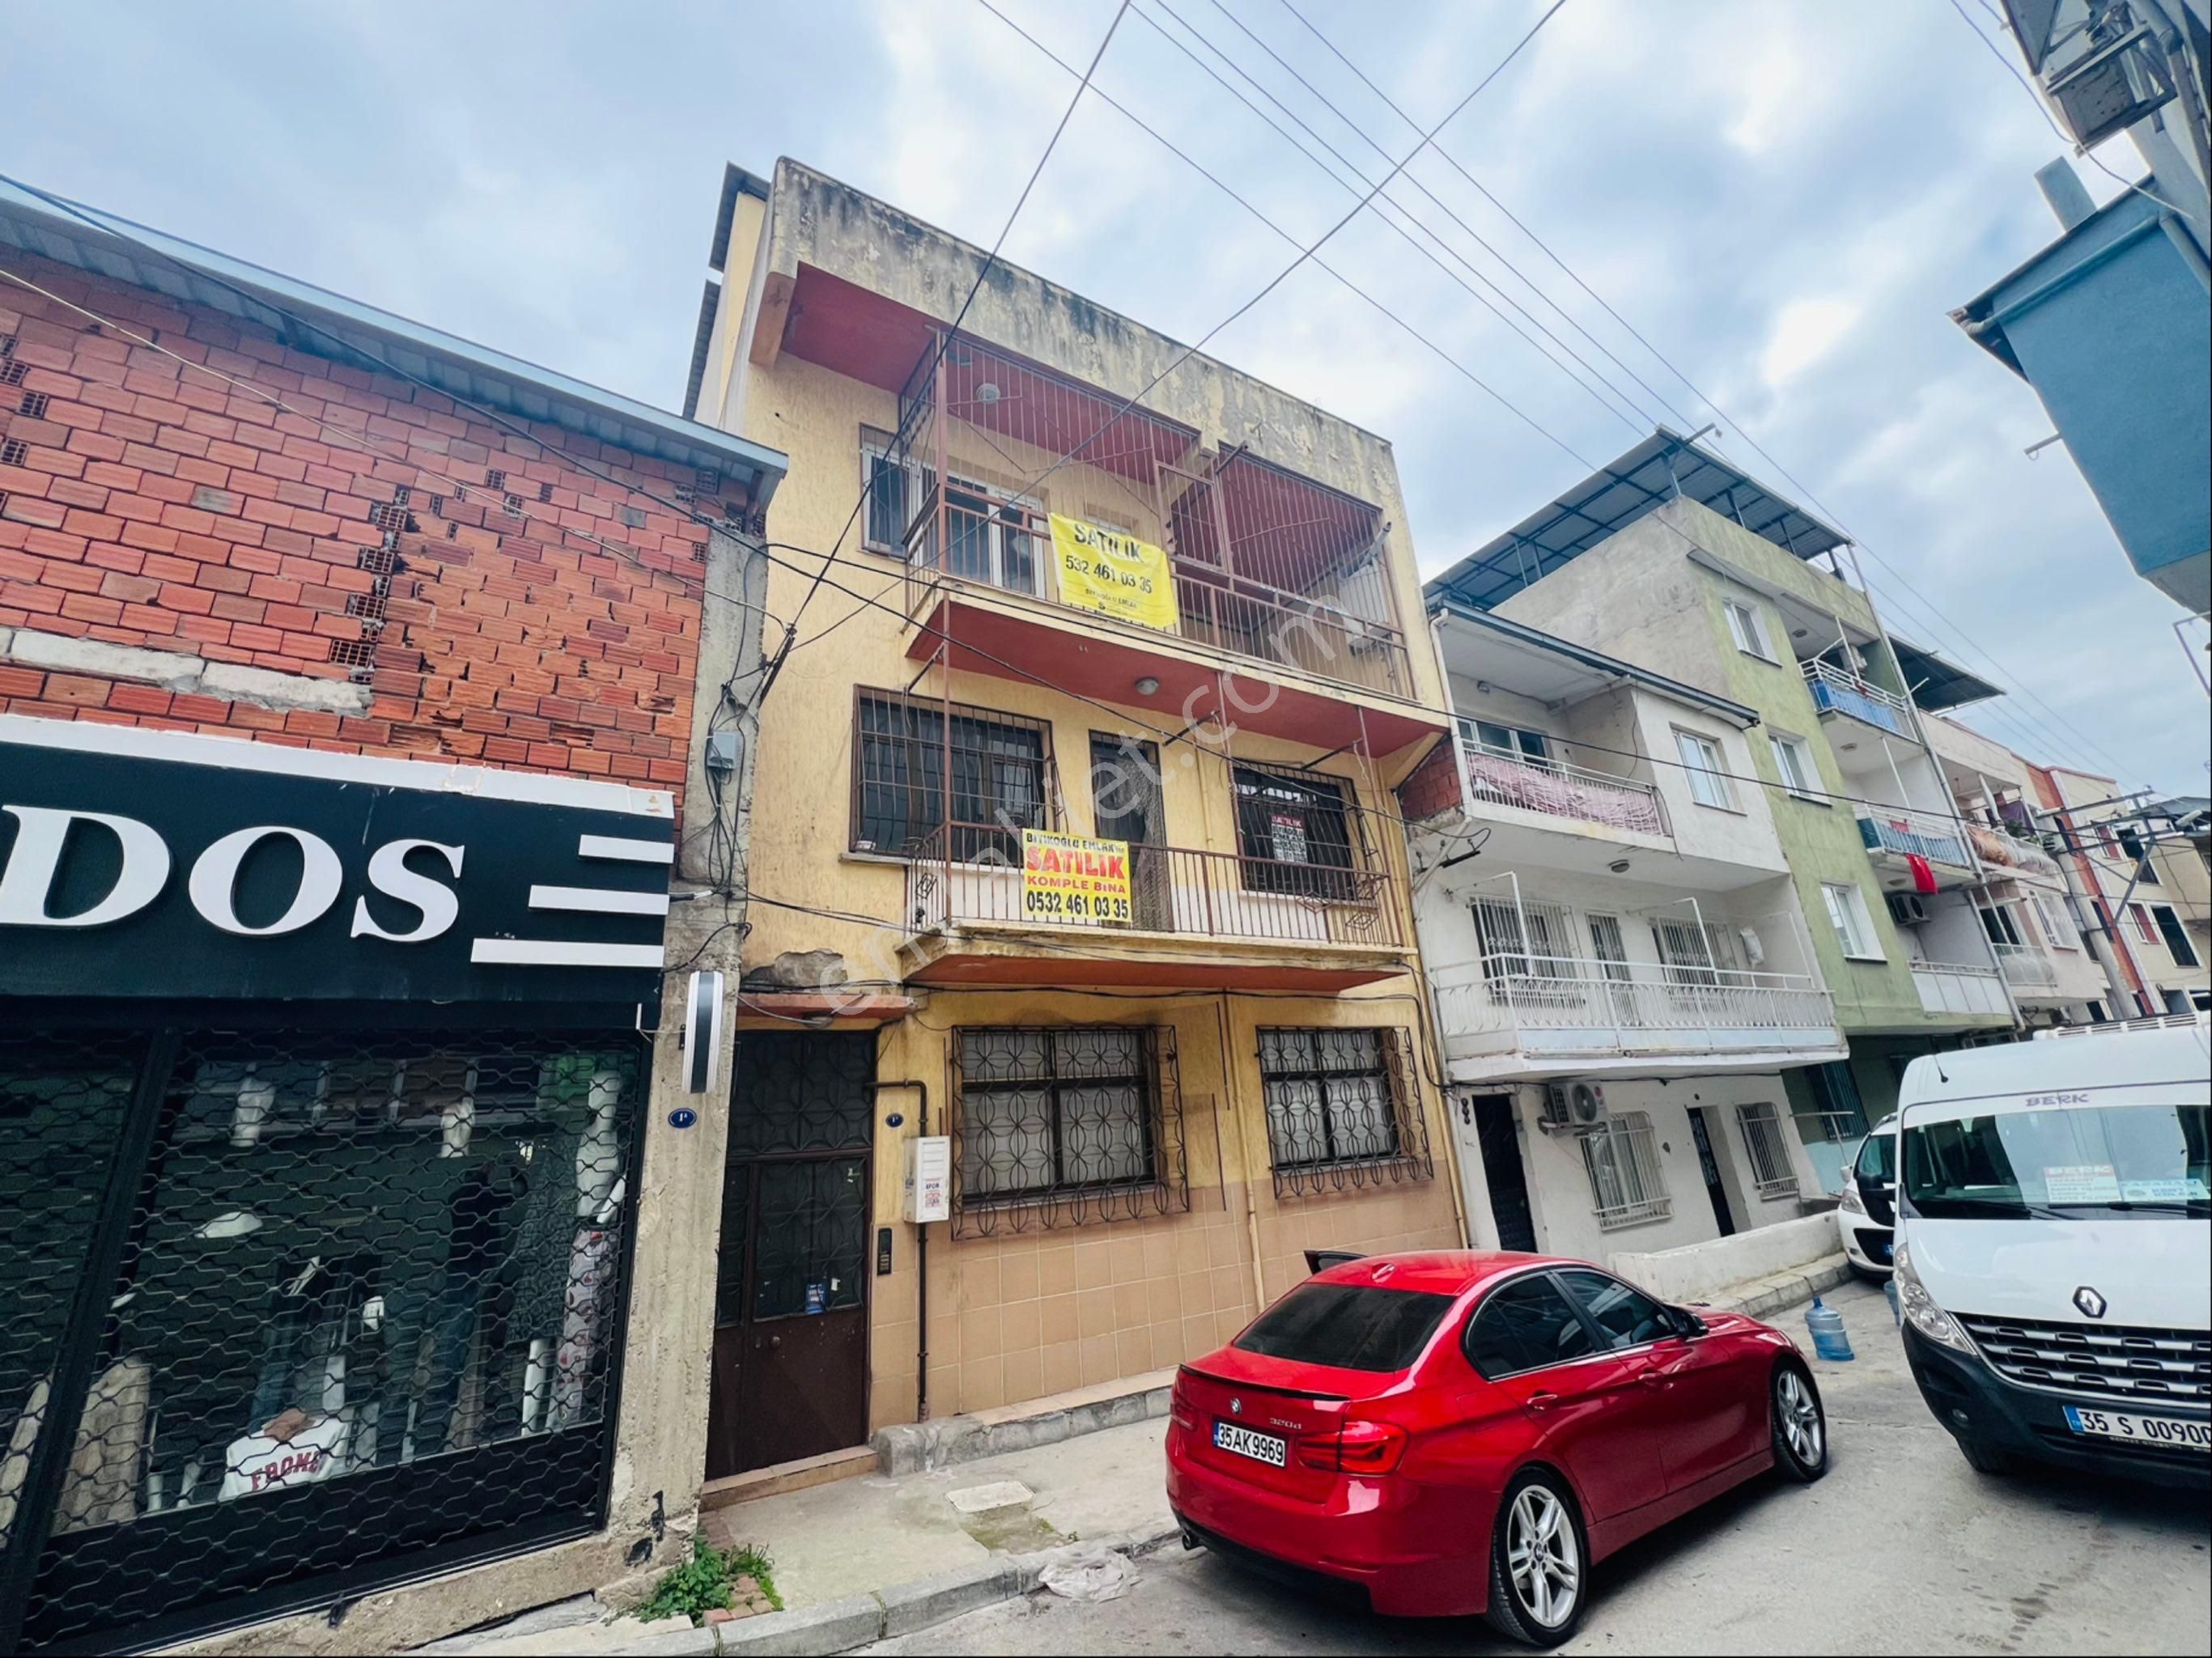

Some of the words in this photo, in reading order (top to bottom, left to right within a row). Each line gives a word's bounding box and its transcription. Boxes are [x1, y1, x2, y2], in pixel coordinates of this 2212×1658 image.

[1074, 524, 1144, 563] SATILIK
[1065, 555, 1089, 575] 532
[1093, 563, 1116, 582] 461
[1121, 571, 1136, 588] 03
[1140, 576, 1153, 593] 35
[0, 804, 466, 943] DOS
[1026, 846, 1125, 880] SATILIK
[1027, 876, 1089, 890] KOMPLE
[1026, 890, 1062, 913] 0532
[1066, 893, 1089, 916] 461
[1094, 896, 1110, 917] 03
[1114, 898, 1128, 918] 35
[2026, 1094, 2089, 1107] BERK
[1269, 1417, 1302, 1430] 320d
[2079, 1411, 2109, 1432] 35
[2117, 1416, 2133, 1435] S
